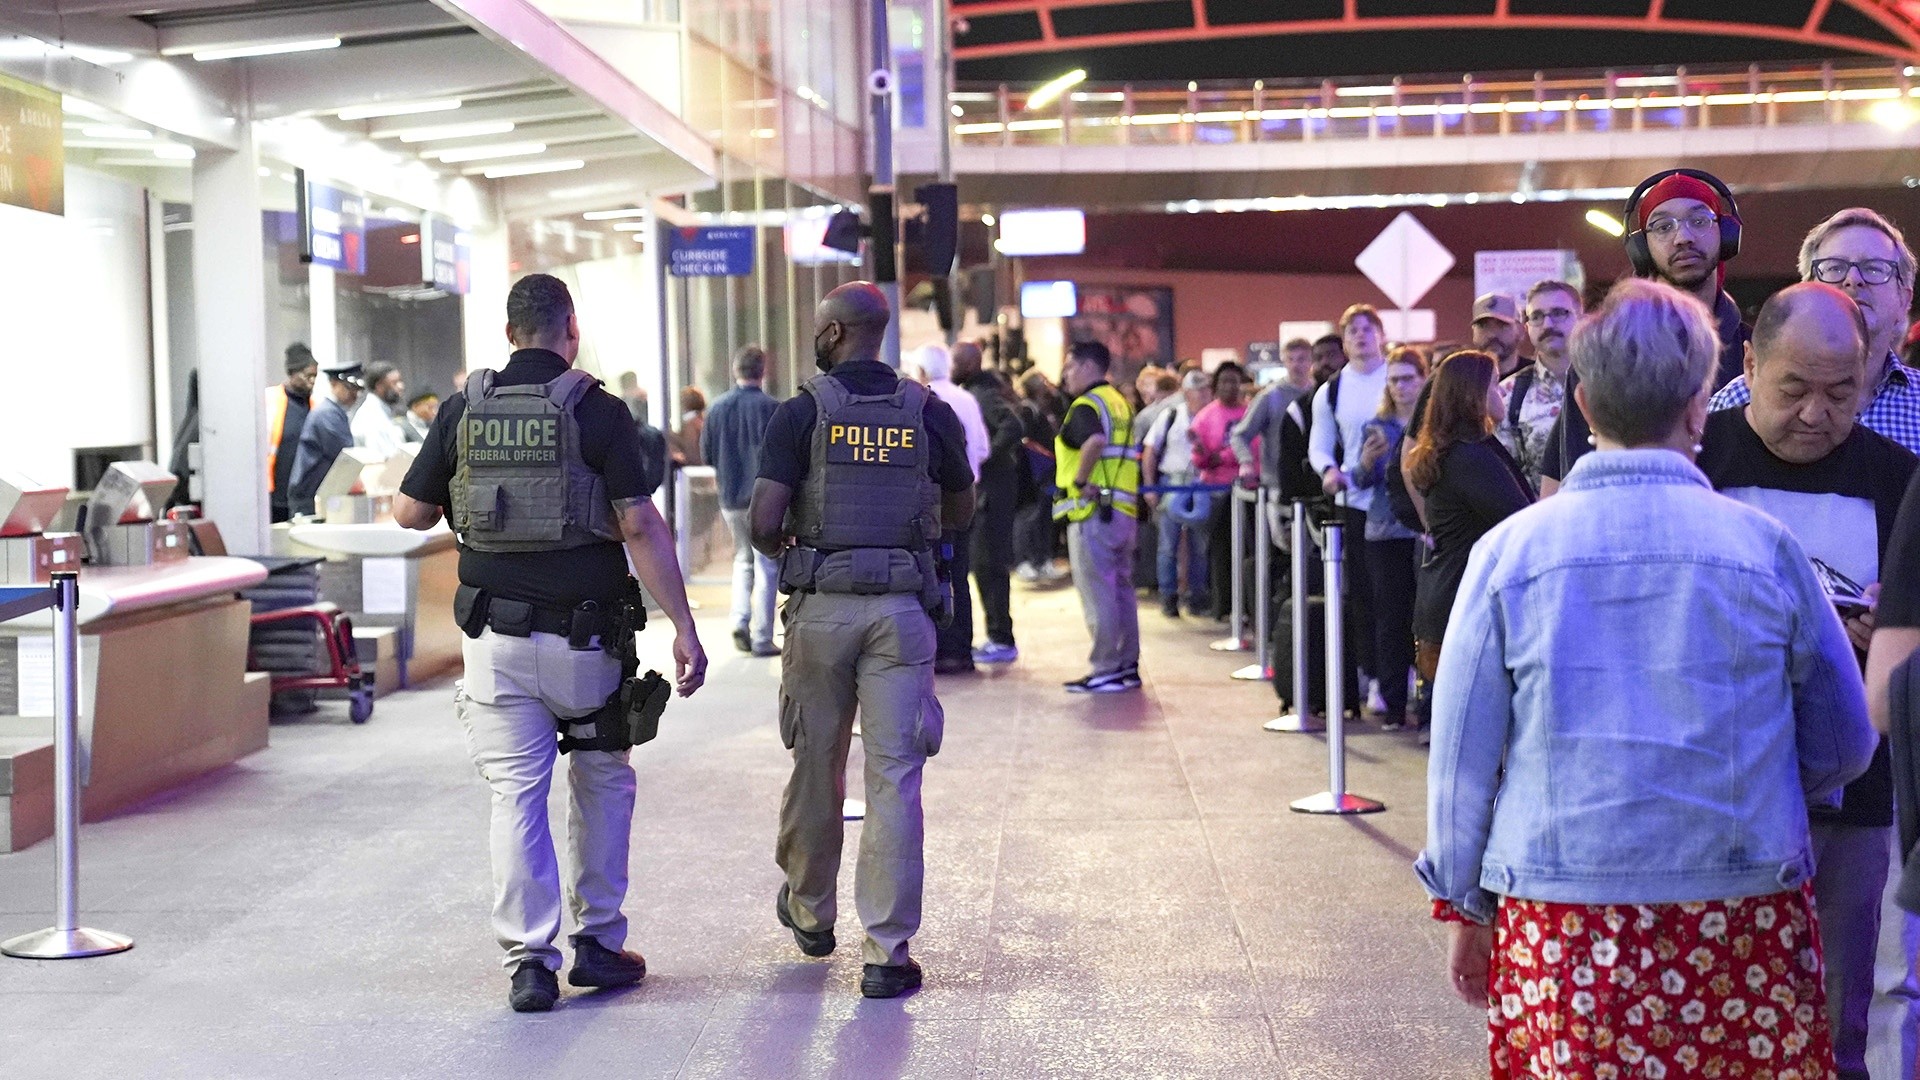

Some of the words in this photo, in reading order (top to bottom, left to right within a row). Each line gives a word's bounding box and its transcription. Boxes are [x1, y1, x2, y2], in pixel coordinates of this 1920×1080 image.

[672, 249, 727, 262] CURBSIDE
[468, 418, 557, 447] POLICE
[830, 425, 915, 449] POLICE
[468, 449, 511, 461] FEDERAL
[513, 449, 557, 461] OFFICER
[853, 446, 891, 463] ICE
